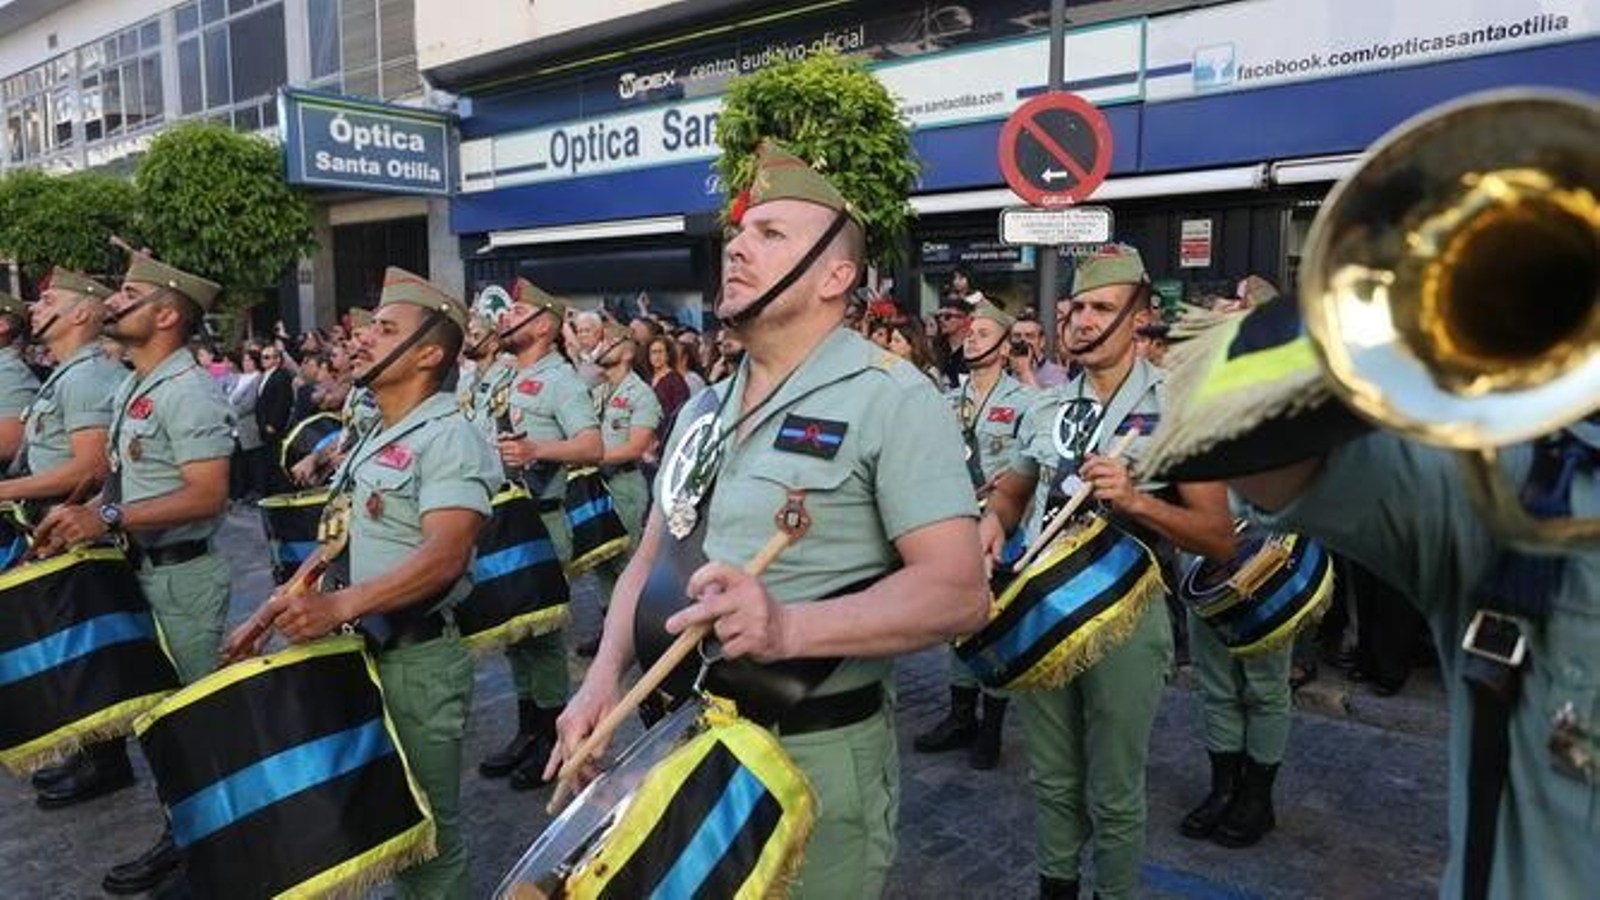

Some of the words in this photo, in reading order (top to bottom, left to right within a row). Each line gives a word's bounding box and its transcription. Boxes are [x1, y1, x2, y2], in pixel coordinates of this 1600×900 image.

[1236, 12, 1569, 81] facebook.com/opticasantaotilia
[690, 60, 737, 80] centro
[329, 112, 425, 153] Óptica
[551, 123, 640, 173] Optica
[315, 151, 382, 176] Santa
[387, 159, 441, 182] Otilia
